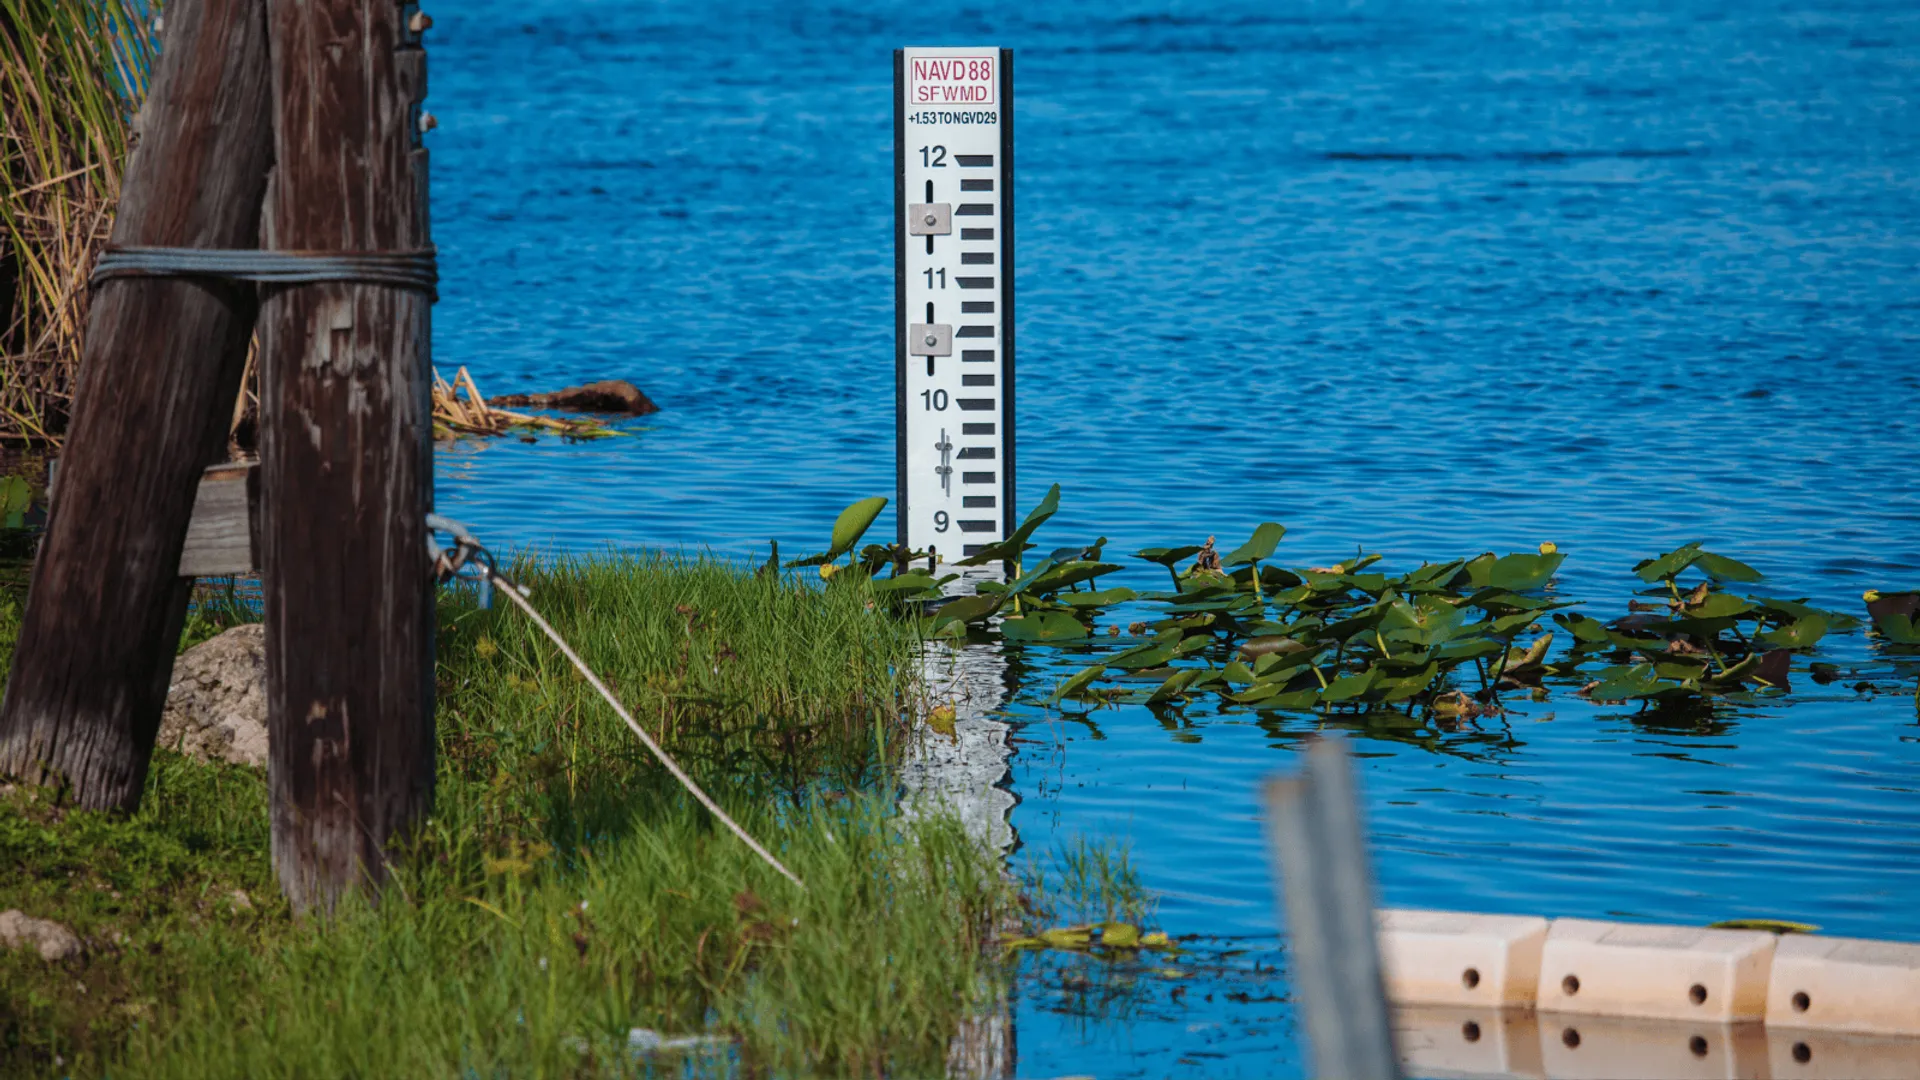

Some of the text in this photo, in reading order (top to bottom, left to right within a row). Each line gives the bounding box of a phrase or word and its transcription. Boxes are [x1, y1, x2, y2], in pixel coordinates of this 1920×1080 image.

[918, 85, 988, 102] SFWMD
[919, 145, 947, 168] 12
[922, 267, 946, 290] 11
[920, 388, 949, 412] 10
[933, 510, 950, 533] 9
